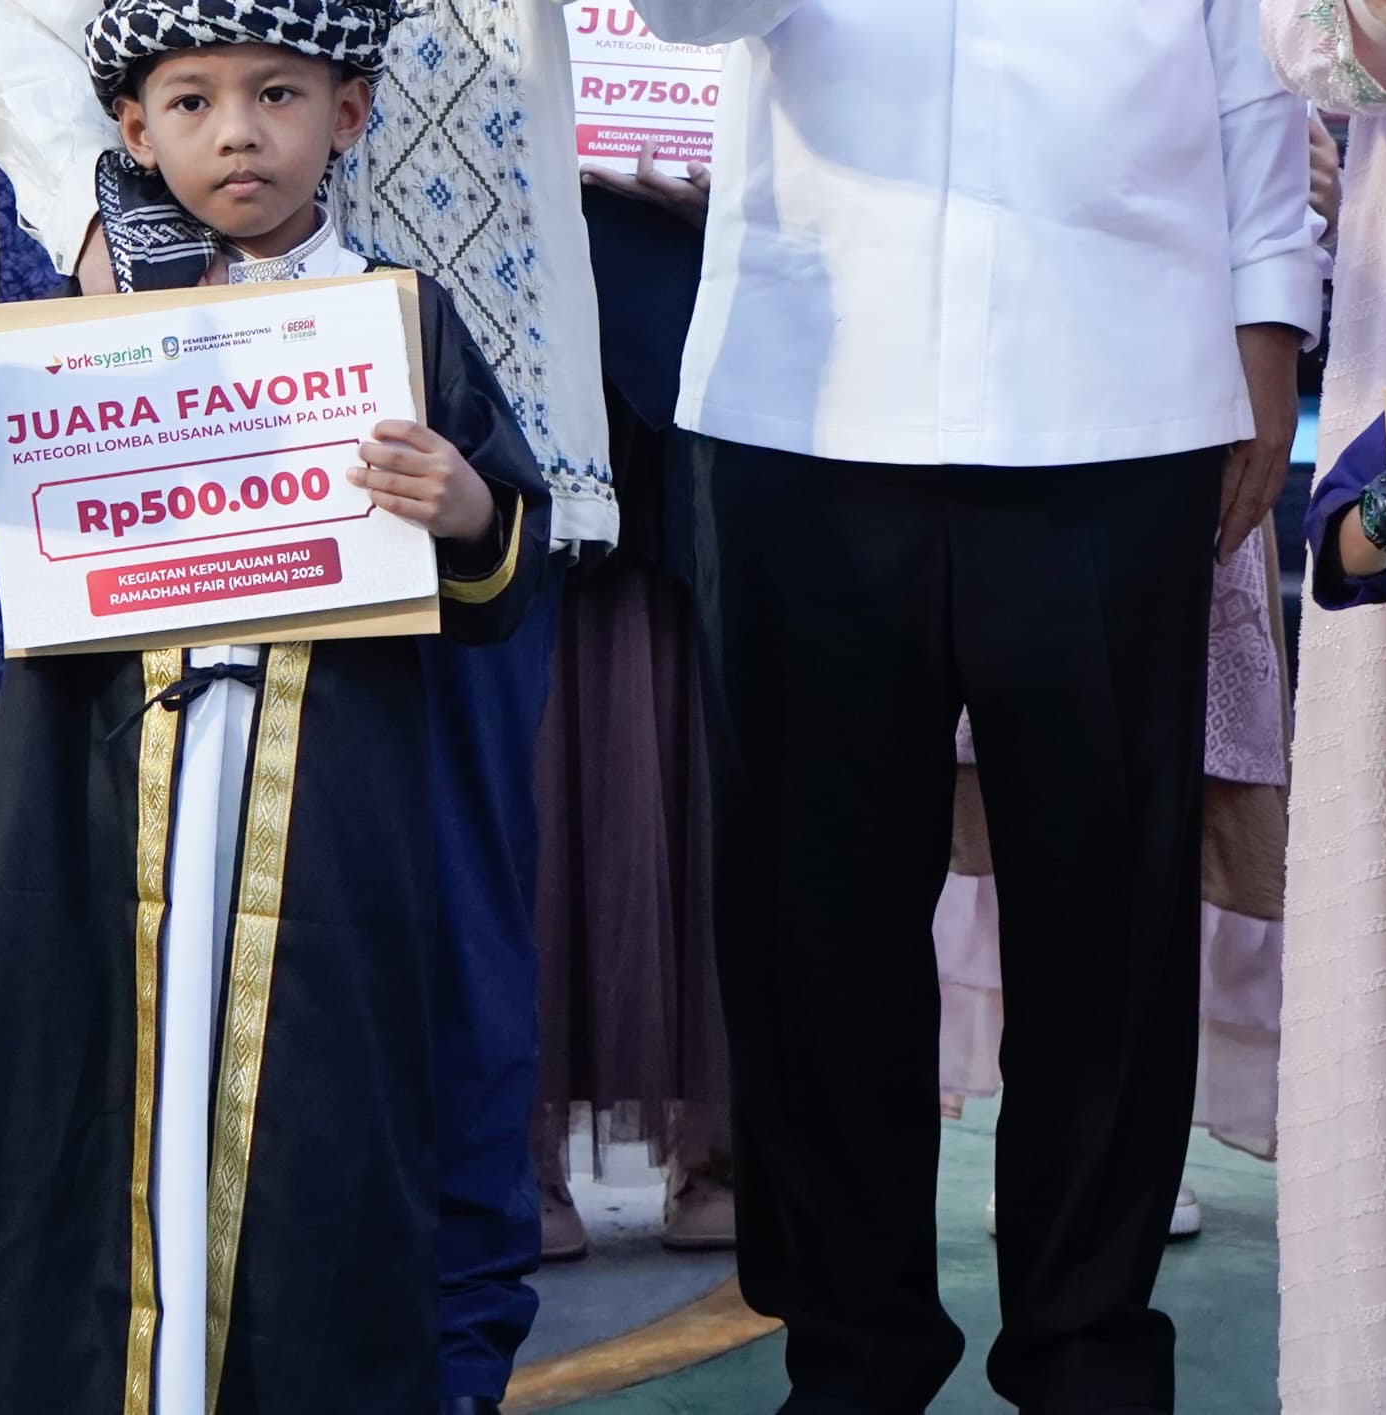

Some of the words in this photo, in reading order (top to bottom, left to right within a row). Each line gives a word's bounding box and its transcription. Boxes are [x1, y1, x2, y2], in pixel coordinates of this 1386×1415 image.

[596, 39, 655, 51] KATEGORI
[659, 44, 702, 55] LOMBA
[597, 130, 649, 141] KEGIATAN
[588, 142, 642, 152] RAMADHA
[182, 334, 233, 345] PEMERINTAH
[235, 327, 271, 337] PROVINSI
[287, 319, 315, 332] GERAK
[183, 342, 231, 353] KEPULAUAN
[233, 338, 252, 347] RIAU
[67, 345, 152, 370] brksyariah
[7, 396, 160, 445] JUARA
[177, 363, 373, 420] FAVORIT
[12, 443, 91, 465] KATEGORI
[96, 434, 154, 453] LOMBA
[158, 424, 224, 444] BUSANA
[229, 414, 292, 434] MUSLIM
[296, 411, 317, 424] PA
[322, 405, 357, 420] DAN
[362, 402, 378, 415] PI
[77, 467, 330, 538] Rp500.000
[118, 566, 187, 588] KEGIATAN
[189, 554, 274, 577] KEPULAUAN
[277, 549, 311, 564] RIAU
[110, 584, 191, 605] RAMADHAN
[194, 579, 226, 593] FAIR
[228, 569, 288, 592] (KURMA)
[291, 564, 324, 581] 2026
